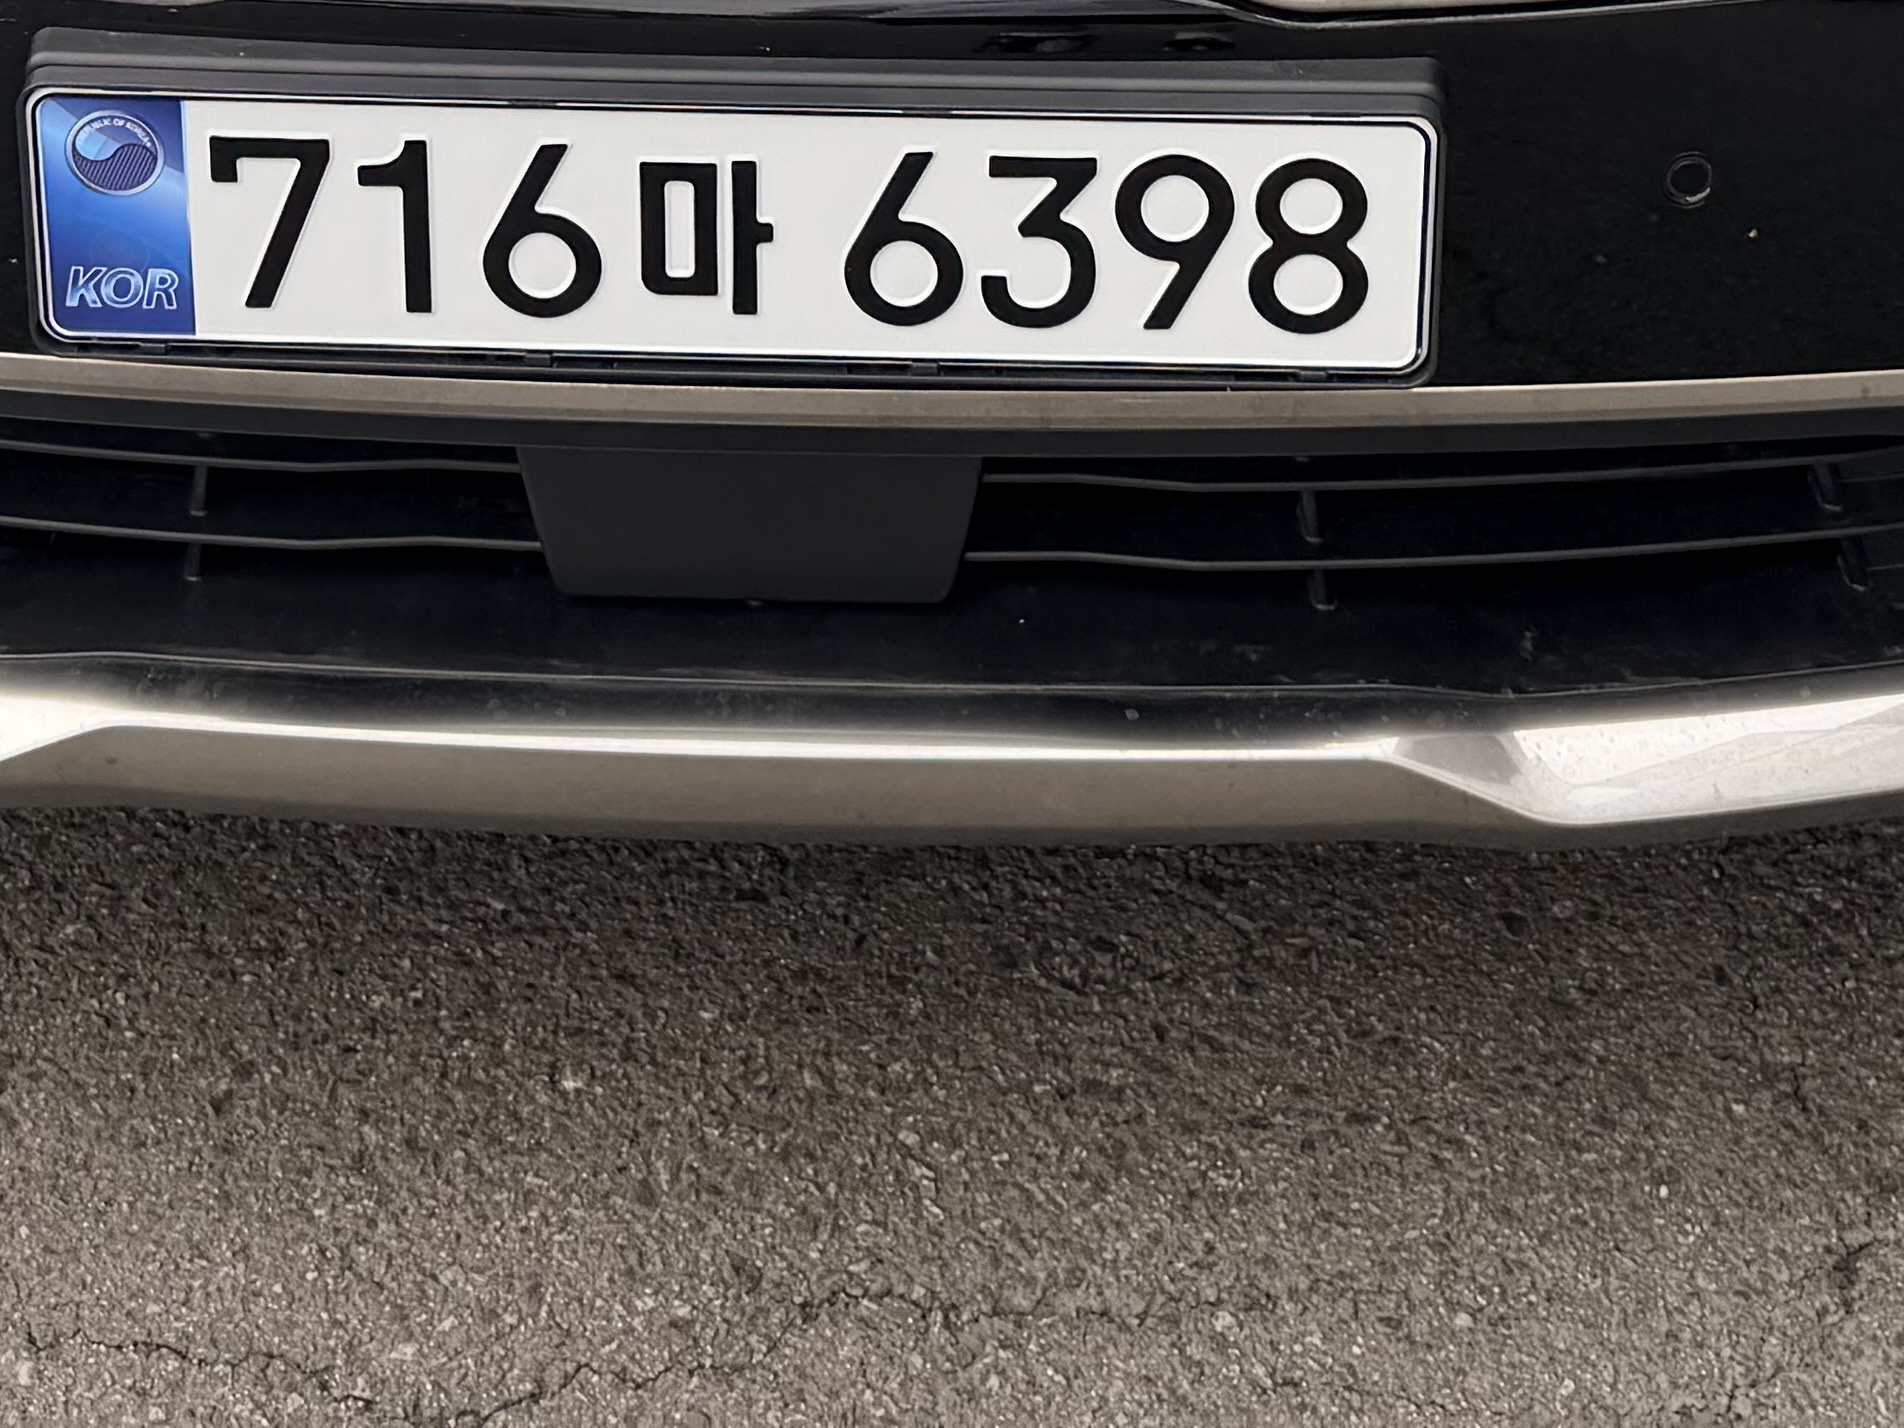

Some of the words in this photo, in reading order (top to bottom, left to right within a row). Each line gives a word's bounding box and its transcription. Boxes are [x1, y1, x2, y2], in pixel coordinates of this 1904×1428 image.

[64, 265, 179, 311] KOR
[208, 134, 776, 322] 716마
[843, 148, 1371, 335] 6398
